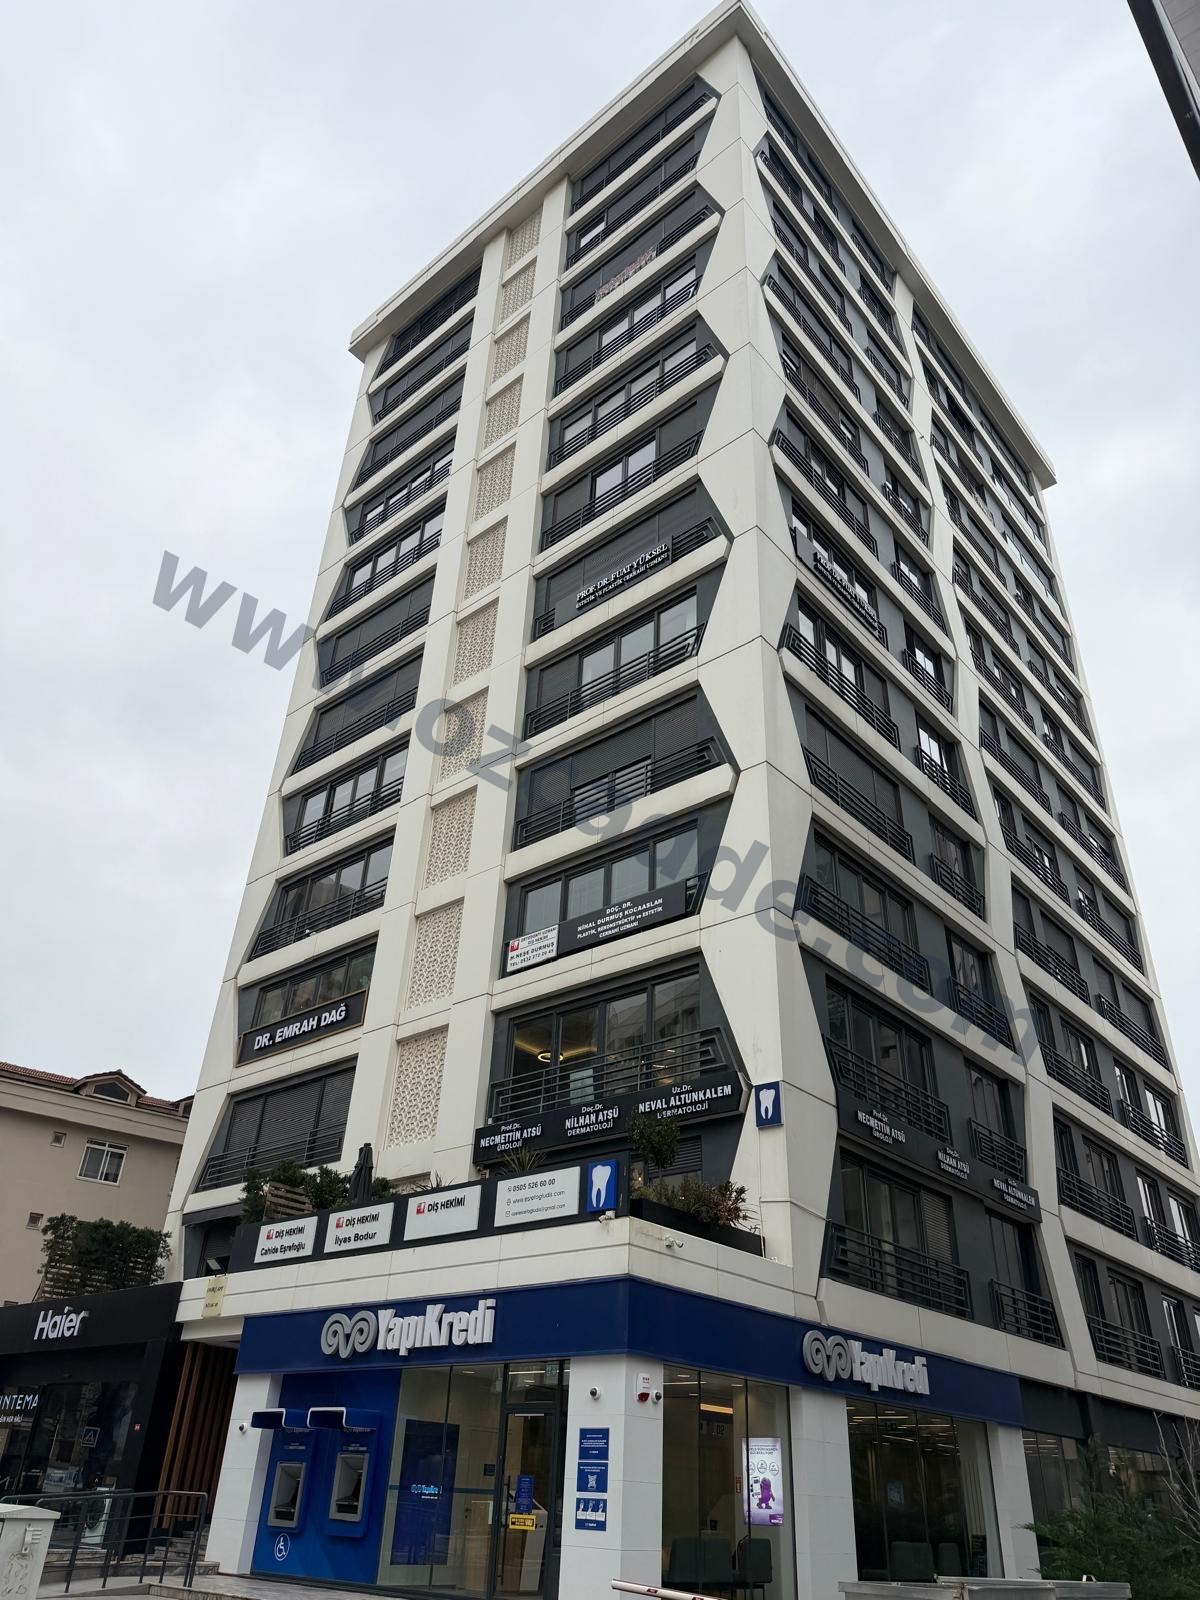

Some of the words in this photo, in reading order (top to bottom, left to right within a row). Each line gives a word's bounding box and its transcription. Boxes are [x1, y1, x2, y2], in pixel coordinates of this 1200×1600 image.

[576, 584, 597, 601] PROF.
[597, 577, 610, 589] DR.
[611, 563, 633, 581] FUAT
[633, 543, 668, 568] YÜKSEL
[577, 921, 596, 931] NİHAL
[597, 912, 623, 925] DURMUŞ
[624, 898, 663, 915] KOCAASLAN
[606, 905, 621, 914] DOÇ.
[622, 901, 633, 909] DR.
[531, 942, 555, 953] DURMUŞ
[254, 1032, 273, 1050] DR.
[275, 1016, 318, 1043] EMRAH
[320, 1002, 346, 1027] DAĞ
[672, 1084, 692, 1094] Uz.Dr.
[638, 1098, 668, 1113] NEVAL
[669, 1085, 732, 1107] ALTUNKALEM
[581, 1104, 604, 1113] Doç.Dr.
[565, 1113, 596, 1129] NİLHAN
[598, 1105, 619, 1123] ATSÜ
[501, 1123, 521, 1132] Prof.Dr.
[567, 1119, 613, 1137] DERMATOLOJİ
[480, 1130, 521, 1148] NECMETTİN
[522, 1124, 542, 1138] ATSÜ
[497, 1139, 523, 1152] ÜROLOJİ
[512, 1184, 527, 1192] 0505
[528, 1181, 538, 1189] 526
[540, 1179, 547, 1187] 60
[427, 1200, 439, 1212] DİŞ
[440, 1195, 466, 1210] HEKİMİ
[345, 1216, 356, 1228] DİŞ
[357, 1212, 380, 1225] HEKİMİ
[274, 1228, 285, 1240] DİŞ
[285, 1224, 305, 1237] HEKİMİ
[334, 1233, 352, 1246] İlyas
[353, 1230, 377, 1242] Bodur
[260, 1242, 279, 1256] Cahide
[33, 1306, 88, 1340] Haier
[377, 1298, 496, 1356] YapıKredi
[847, 1339, 930, 1395] YapıKredi
